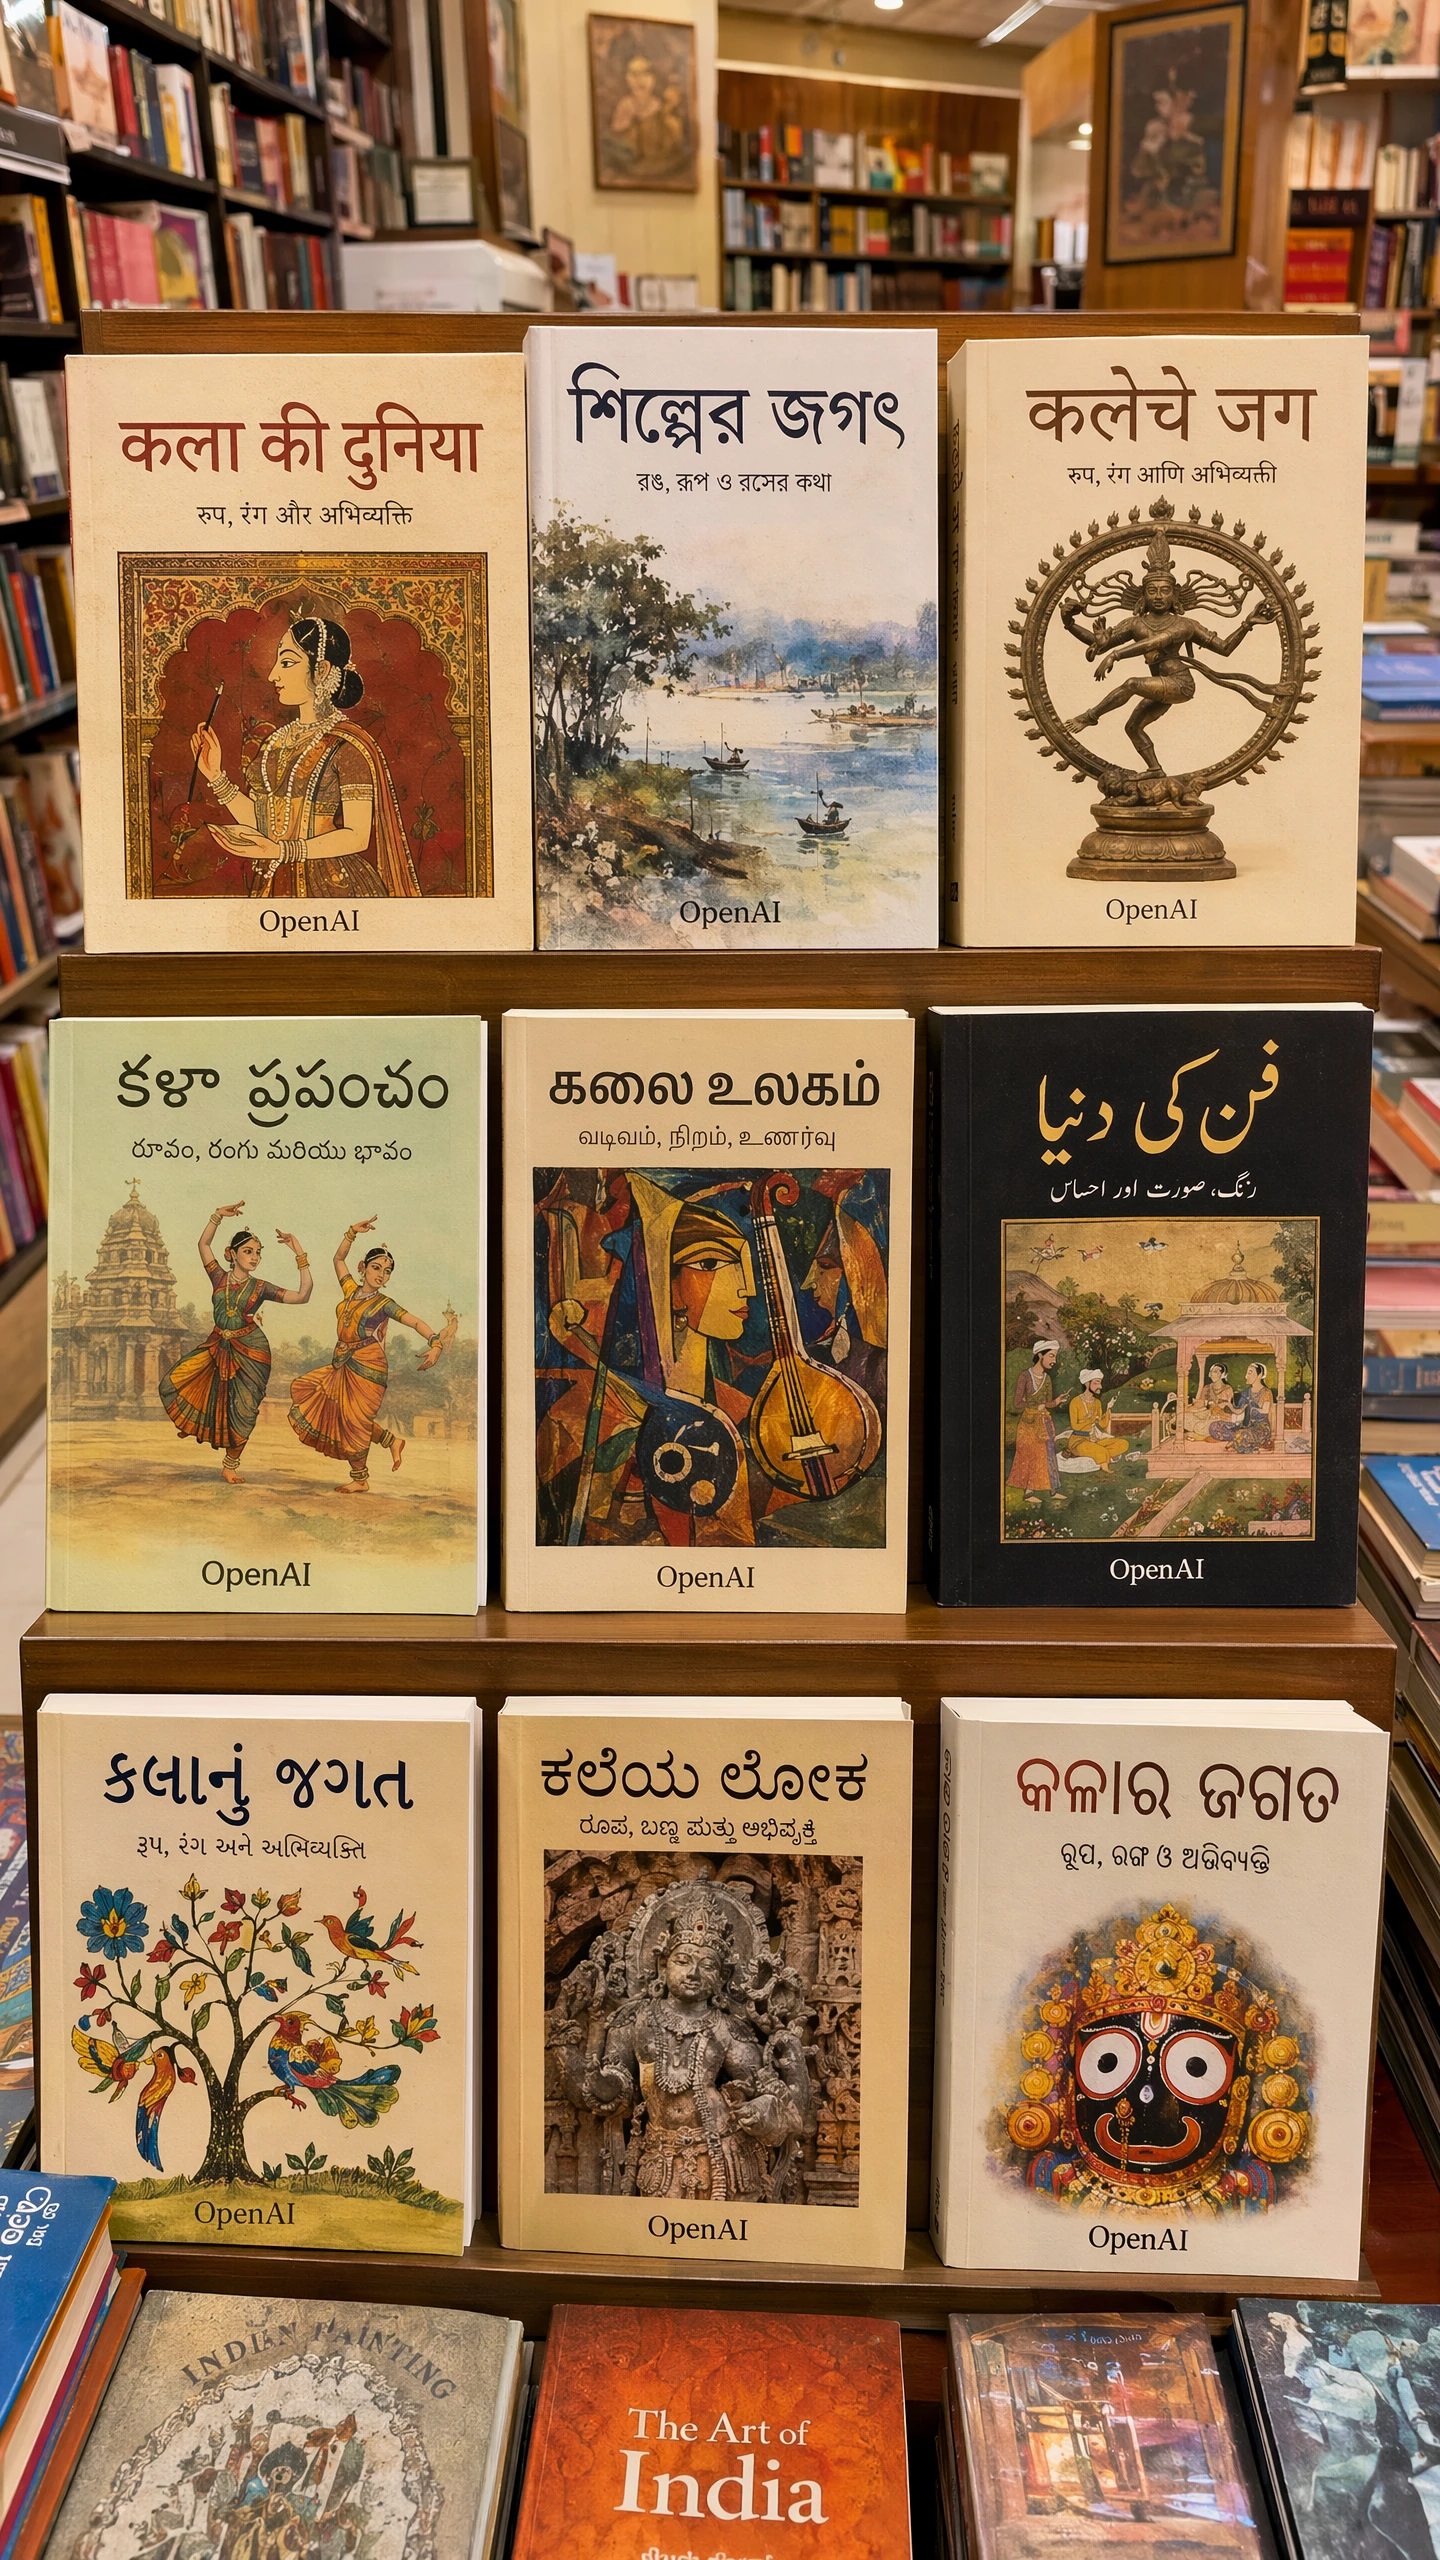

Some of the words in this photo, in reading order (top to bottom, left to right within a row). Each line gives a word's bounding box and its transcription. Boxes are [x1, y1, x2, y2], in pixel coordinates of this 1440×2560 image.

[566, 362, 751, 454] শিল্পের
[767, 390, 905, 449] জগৎ
[1025, 366, 1197, 442] कलेचे
[1215, 389, 1318, 442] जग
[118, 423, 246, 472] कला
[259, 402, 330, 473] की
[341, 402, 484, 490] दुनिया
[636, 474, 669, 494] রঙ,
[676, 472, 709, 491] রূপ
[717, 474, 732, 490] ও
[738, 474, 789, 492] রসের
[795, 473, 832, 492] কথা
[1106, 463, 1131, 484] रंग
[1137, 461, 1185, 483] आणि
[1191, 460, 1277, 483] अभिव्यक्ती
[240, 502, 267, 524] रंग
[276, 500, 312, 525] और
[319, 500, 413, 525] अभिव्यक्ति
[260, 910, 359, 938] OpenAI
[679, 900, 781, 930] OpenAI
[1106, 899, 1197, 925] OpenAI
[117, 1054, 220, 1108] కళా
[247, 1058, 449, 1128] ప్రపంచం
[549, 1071, 693, 1105] கலை
[708, 1059, 879, 1106] உலகம்
[1199, 1039, 1280, 1154] فن
[1134, 1048, 1220, 1154] کی
[1039, 1074, 1114, 1166] دنیا
[209, 1139, 258, 1159] రంగు
[267, 1139, 346, 1160] మరియు
[354, 1140, 412, 1164] భావం
[579, 1125, 661, 1151] வடிவம்,
[669, 1124, 732, 1151] நிறம்,
[739, 1126, 835, 1151] உணர்வு
[1051, 1179, 1105, 1203] احساس
[1113, 1179, 1137, 1199] اور
[1147, 1181, 1205, 1199] صورت
[202, 1561, 311, 1592] OpenAI
[657, 1566, 755, 1594] OpenAI
[1110, 1559, 1204, 1585] OpenAI
[103, 1743, 250, 1826] કલાનું
[276, 1758, 414, 1809] જગત
[541, 1747, 699, 1799] ಕಲೆಯ
[721, 1750, 868, 1801] ಲೋಕ
[1017, 1758, 1171, 1819] କଳାର
[1199, 1763, 1339, 1823] ଜଗତ
[580, 1814, 633, 1838] ರೂಪ,
[641, 1820, 680, 1844] ಬಣ್ಣ
[137, 1837, 168, 1858] રૂપ,
[179, 1833, 207, 1855] રંગ
[216, 1833, 253, 1856] અને
[262, 1834, 366, 1859] અભિવ્યક્તિ
[1157, 1845, 1172, 1868] ଓ
[194, 2200, 296, 2231] OpenAI
[648, 2215, 748, 2244] OpenAI
[1087, 2223, 1190, 2255] OpenAI
[180, 2321, 297, 2387] INDIAN
[310, 2317, 458, 2400] PAINTING
[628, 2408, 698, 2442] The
[706, 2412, 770, 2444] Art
[780, 2420, 811, 2446] of
[613, 2450, 829, 2524] India
